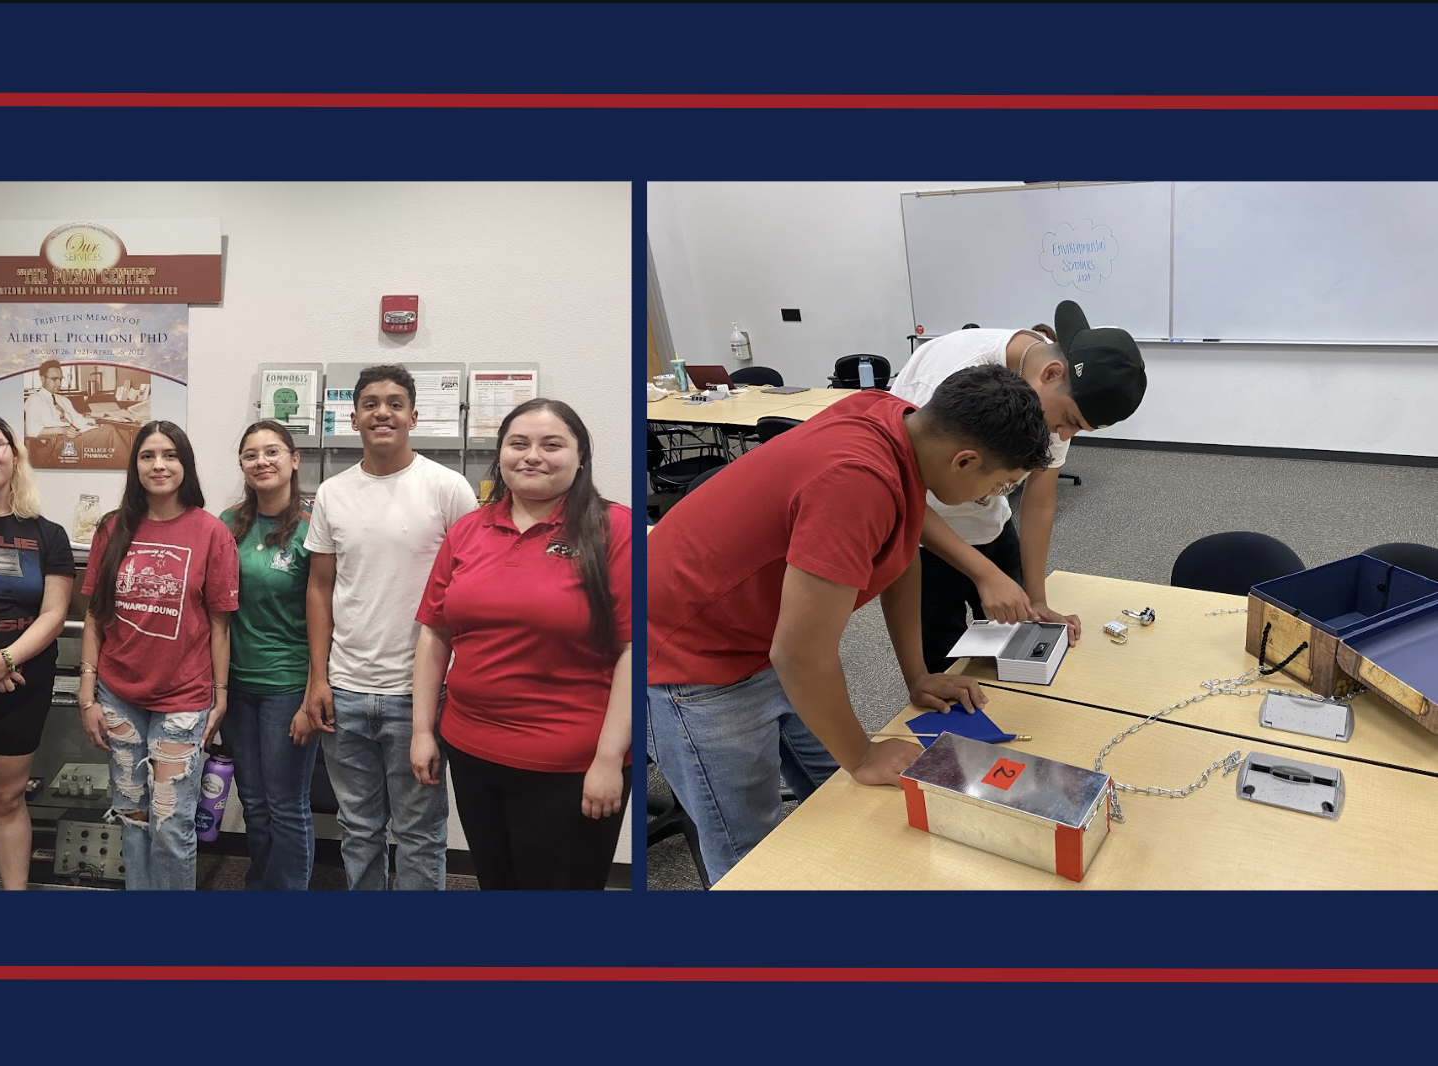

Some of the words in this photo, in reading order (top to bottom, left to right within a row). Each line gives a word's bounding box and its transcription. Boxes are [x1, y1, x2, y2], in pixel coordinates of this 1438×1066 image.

[66, 233, 99, 253] Our
[64, 253, 102, 261] SERVICES
[52, 268, 97, 284] POISON
[29, 287, 58, 295] POISON
[69, 287, 89, 295] DRUG
[93, 287, 145, 295] INFORMATION
[149, 287, 178, 295] CENTER
[33, 314, 71, 326] TRIBUTE
[73, 313, 82, 321] IN
[86, 313, 127, 324] MEMORY
[128, 317, 141, 326] OF
[7, 332, 50, 343] ALBERT
[266, 374, 308, 383] CANNABIS
[148, 604, 179, 617] BOUND
